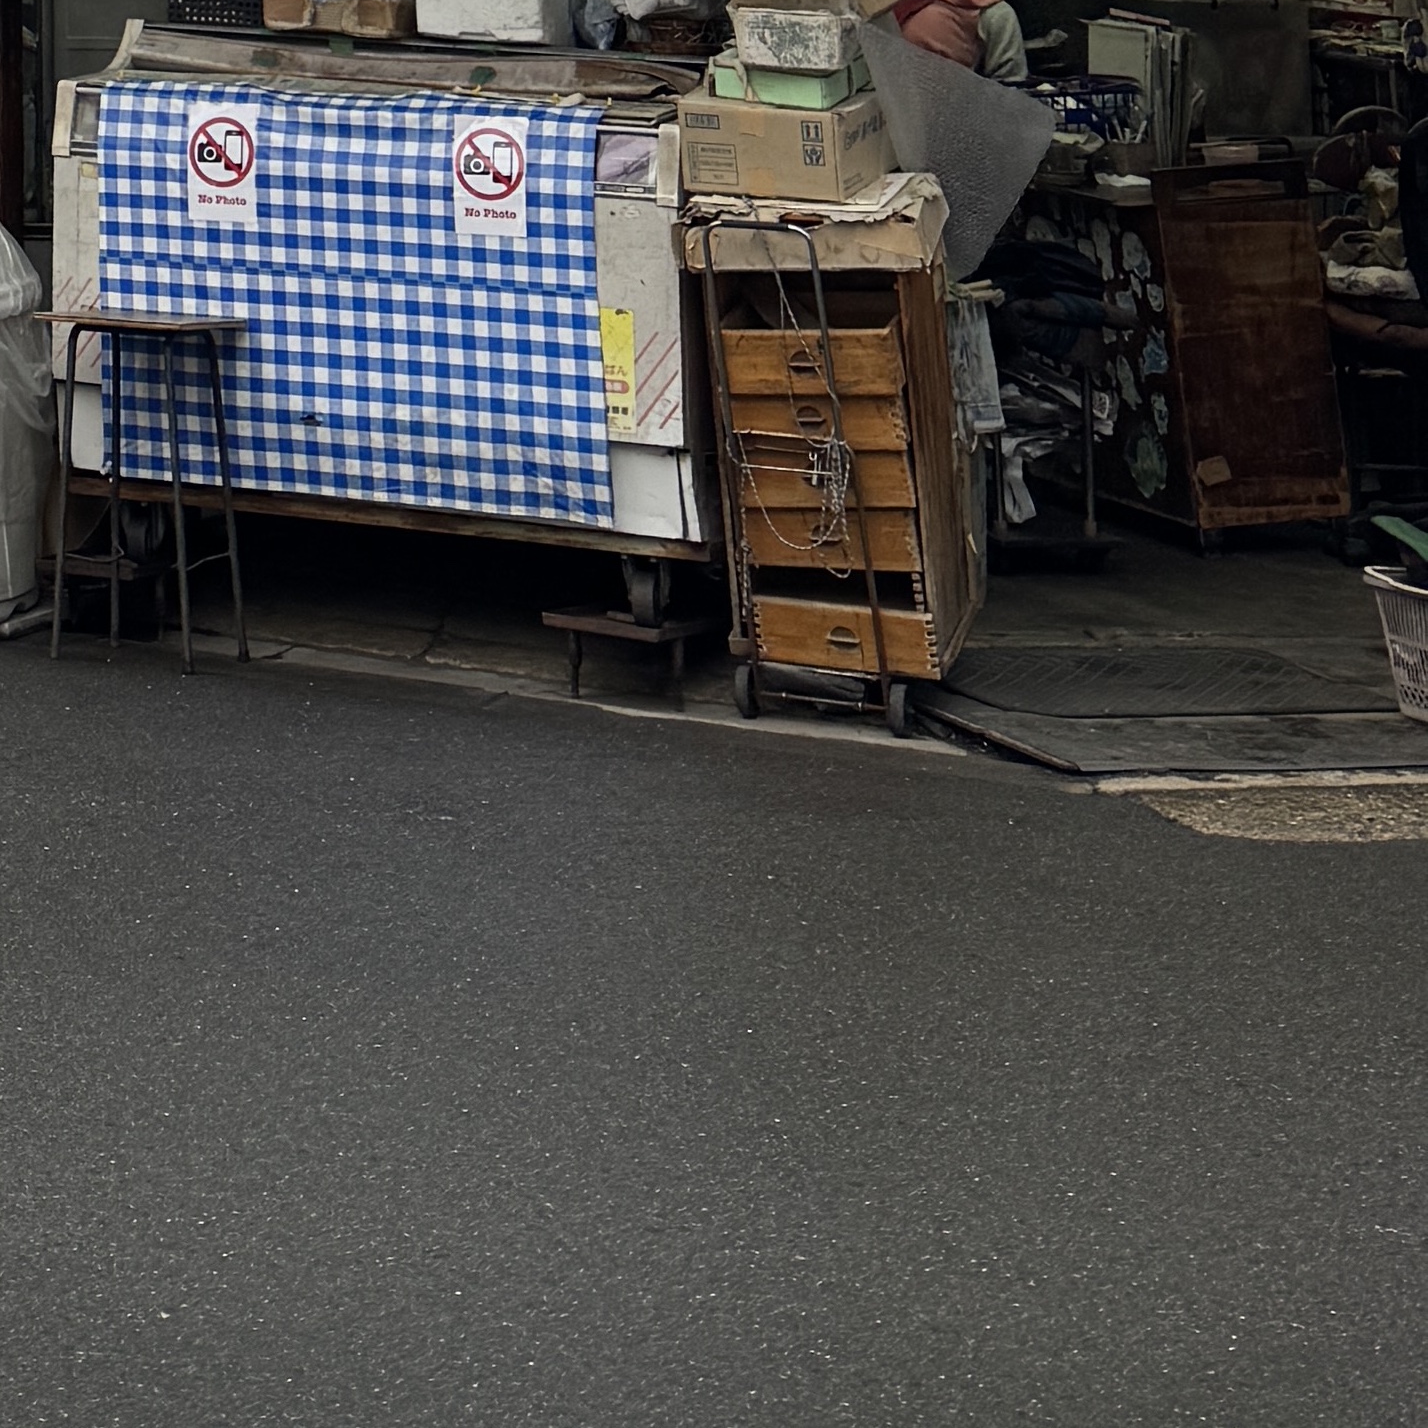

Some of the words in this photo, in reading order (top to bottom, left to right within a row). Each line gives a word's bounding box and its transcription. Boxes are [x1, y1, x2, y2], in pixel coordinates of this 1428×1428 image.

[198, 194, 212, 206] No
[214, 194, 247, 208] Photo
[464, 207, 481, 220] No
[484, 208, 517, 222] Photo
